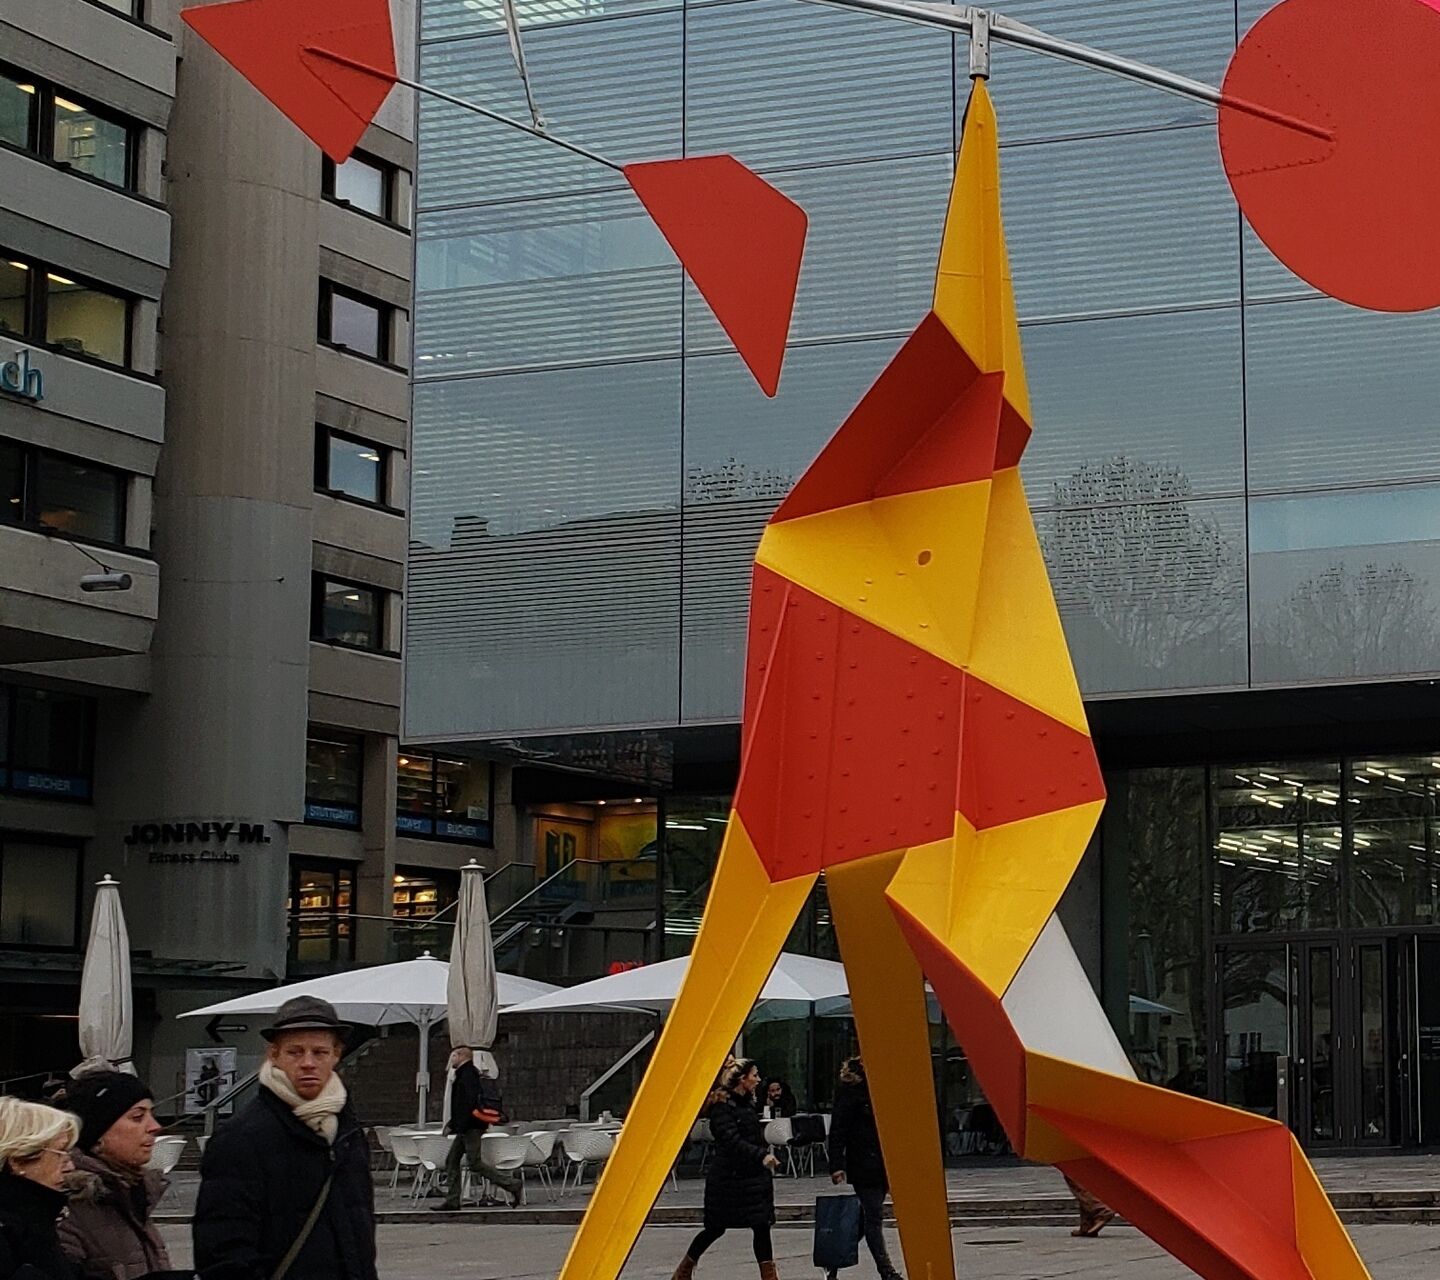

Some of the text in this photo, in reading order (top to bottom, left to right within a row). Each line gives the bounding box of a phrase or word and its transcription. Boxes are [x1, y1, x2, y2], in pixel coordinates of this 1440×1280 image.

[124, 822, 271, 845] JONNY M.
[199, 849, 240, 864] Clubs
